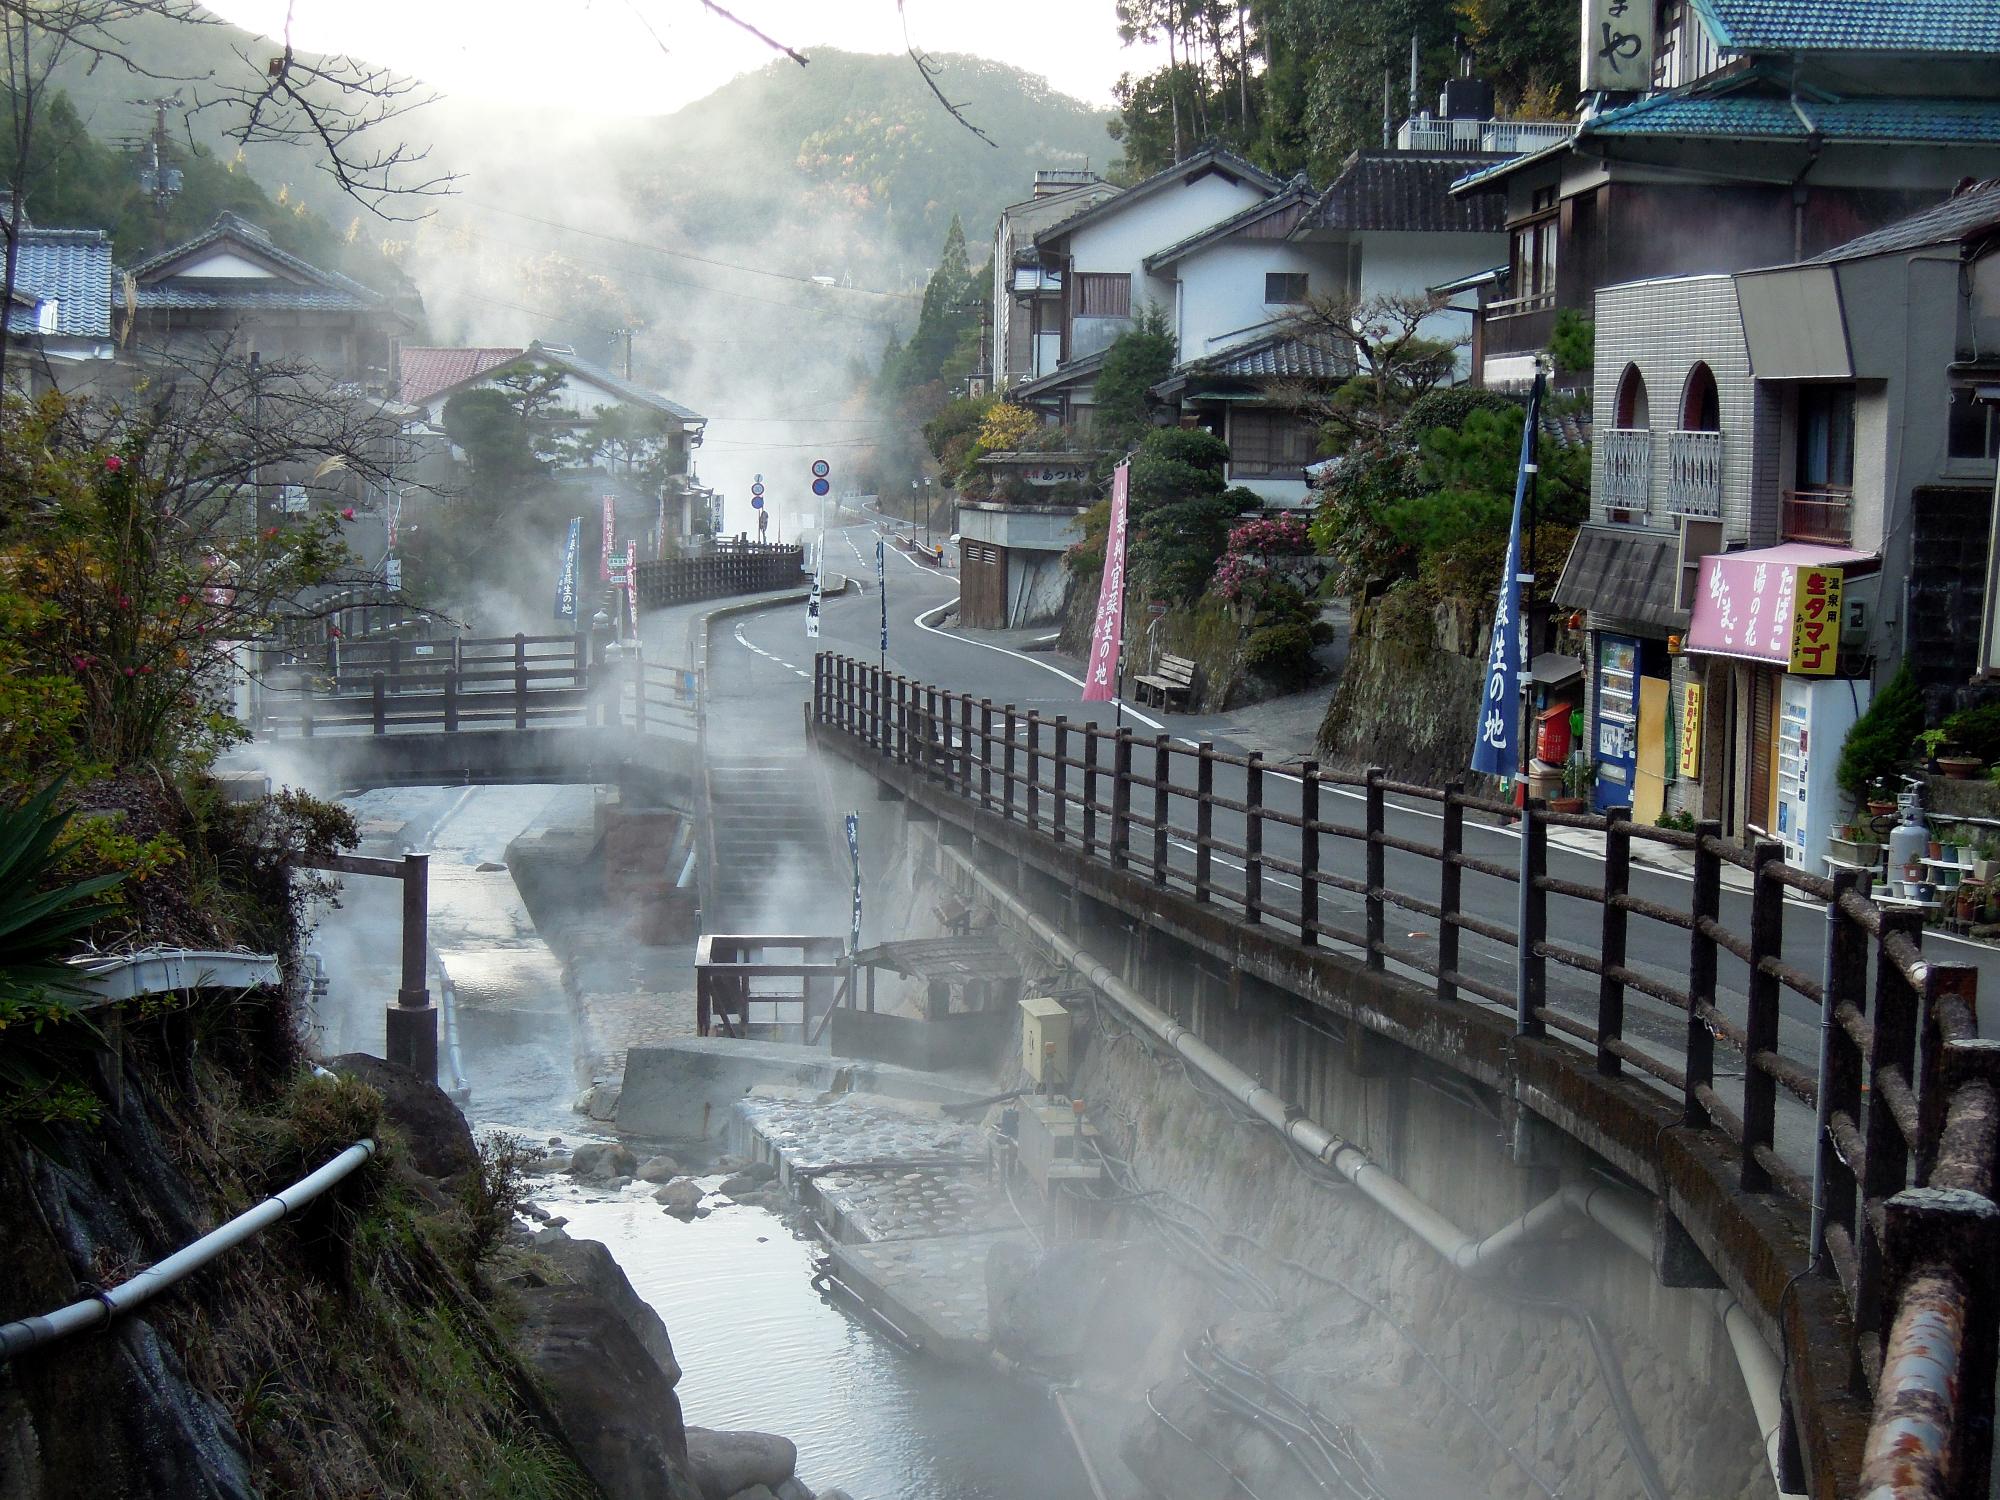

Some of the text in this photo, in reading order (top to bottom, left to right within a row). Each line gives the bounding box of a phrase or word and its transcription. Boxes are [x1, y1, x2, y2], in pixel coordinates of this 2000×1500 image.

[815, 464, 826, 473] 30
[1094, 481, 1125, 686] 小栗判官蘇生の地
[1744, 562, 1767, 646] 湯の花
[1770, 566, 1794, 651] たばこ
[1801, 572, 1830, 669] 生タマゴ
[1826, 577, 1840, 623] 温泉用
[1792, 613, 1805, 658] あります
